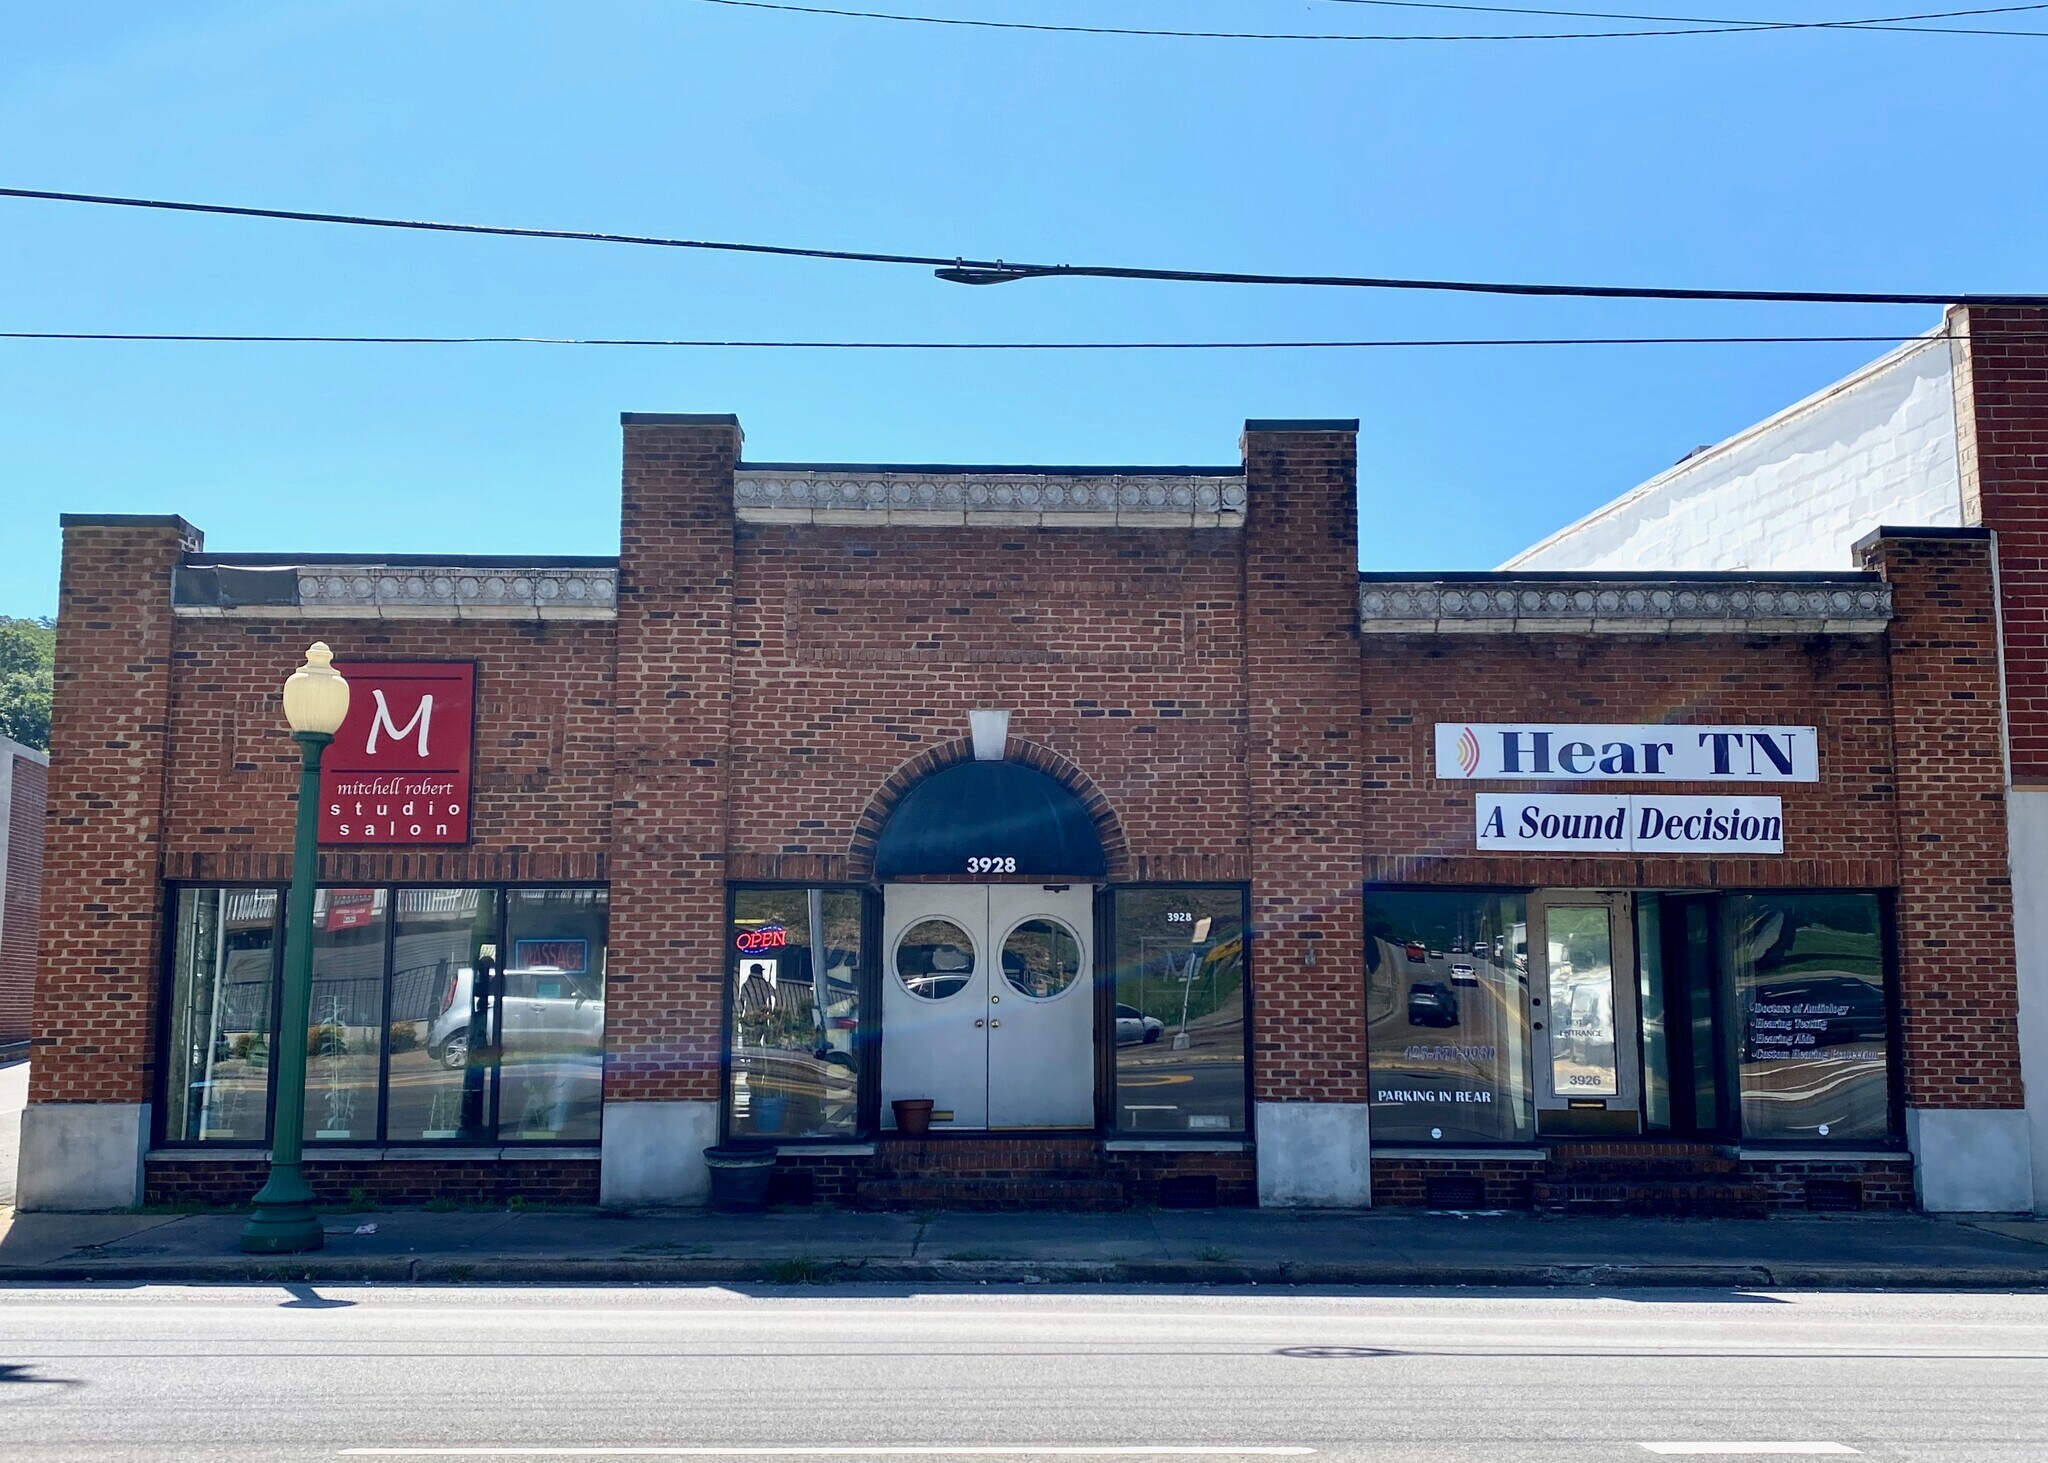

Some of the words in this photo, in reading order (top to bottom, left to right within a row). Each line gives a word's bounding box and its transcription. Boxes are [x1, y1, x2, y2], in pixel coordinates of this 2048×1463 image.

[366, 689, 433, 757] M
[1498, 731, 1673, 774] Hear
[1699, 733, 1796, 775] TN
[337, 777, 403, 795] mitchell
[404, 777, 454, 795] robert
[330, 801, 460, 816] studio
[339, 821, 447, 836] salon
[1480, 805, 1506, 838] A
[1518, 805, 1626, 840] Sound
[1637, 807, 1781, 842] Decision
[967, 856, 1016, 873] 3928
[1167, 912, 1192, 922] 3928
[736, 930, 787, 950] OPEN
[520, 943, 583, 969] MASSAGE
[1754, 1003, 1791, 1014] Doctors
[1792, 1003, 1804, 1014] of
[1804, 1004, 1849, 1016] Audiology
[1755, 1018, 1792, 1030] Hearing
[1794, 1018, 1828, 1031] Testing
[1560, 1029, 1604, 1037] ENTRANCE
[1756, 1033, 1793, 1046] Hearing
[1794, 1033, 1816, 1044] Aids
[1756, 1049, 1791, 1059] Custom
[1791, 1049, 1830, 1061] Hearing
[1569, 1075, 1601, 1086] 3926
[1378, 1090, 1435, 1102] PARKING
[1439, 1091, 1452, 1102] IN
[1455, 1091, 1491, 1103] REAR
